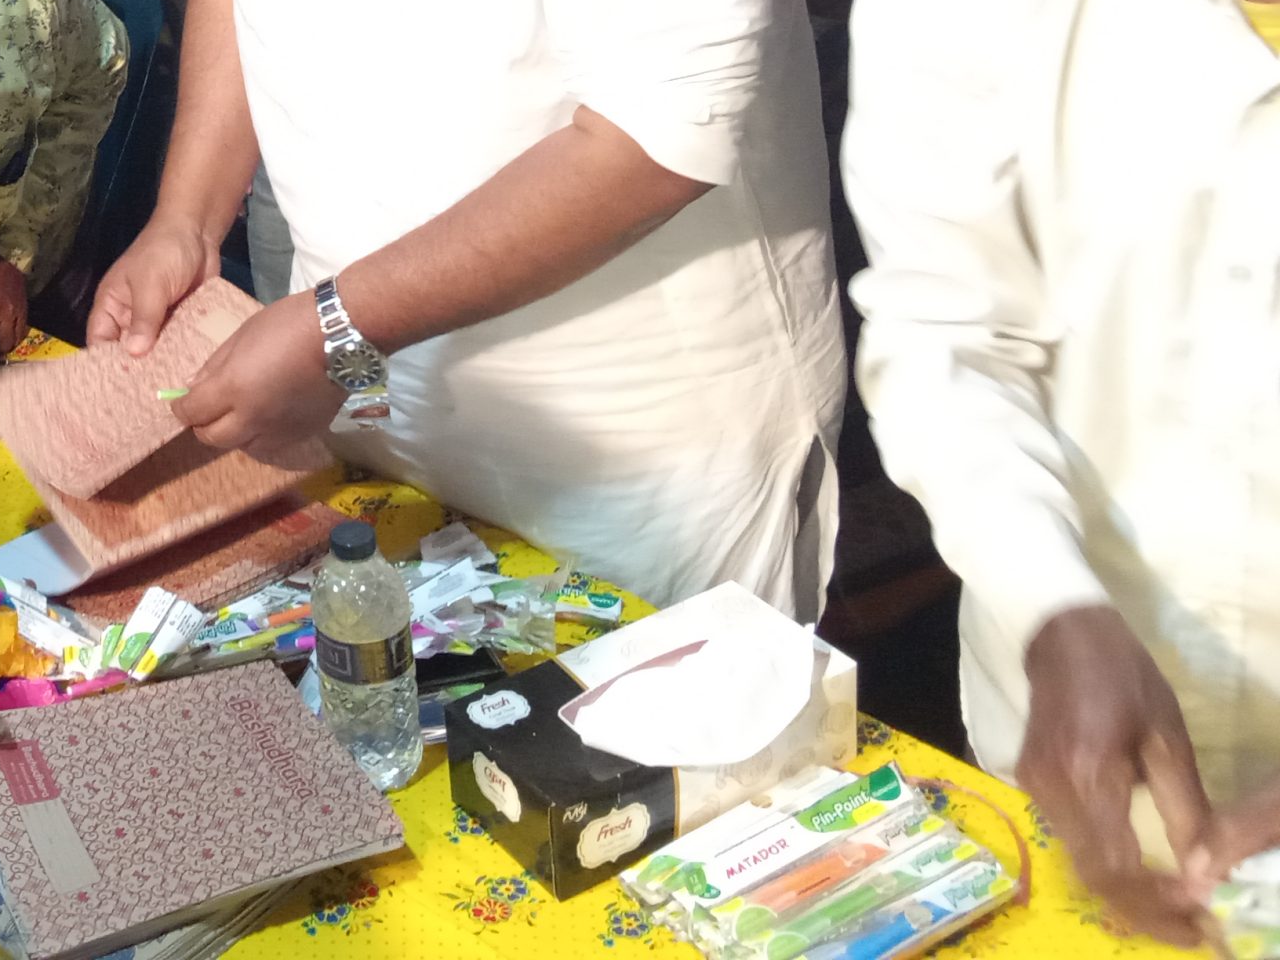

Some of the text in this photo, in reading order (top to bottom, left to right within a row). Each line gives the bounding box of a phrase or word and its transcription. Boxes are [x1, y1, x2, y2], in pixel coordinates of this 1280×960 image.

[480, 696, 511, 716] Fresh
[811, 784, 871, 831] Pin-Point
[596, 815, 633, 842] Fresh
[725, 838, 789, 879] MATADOR
